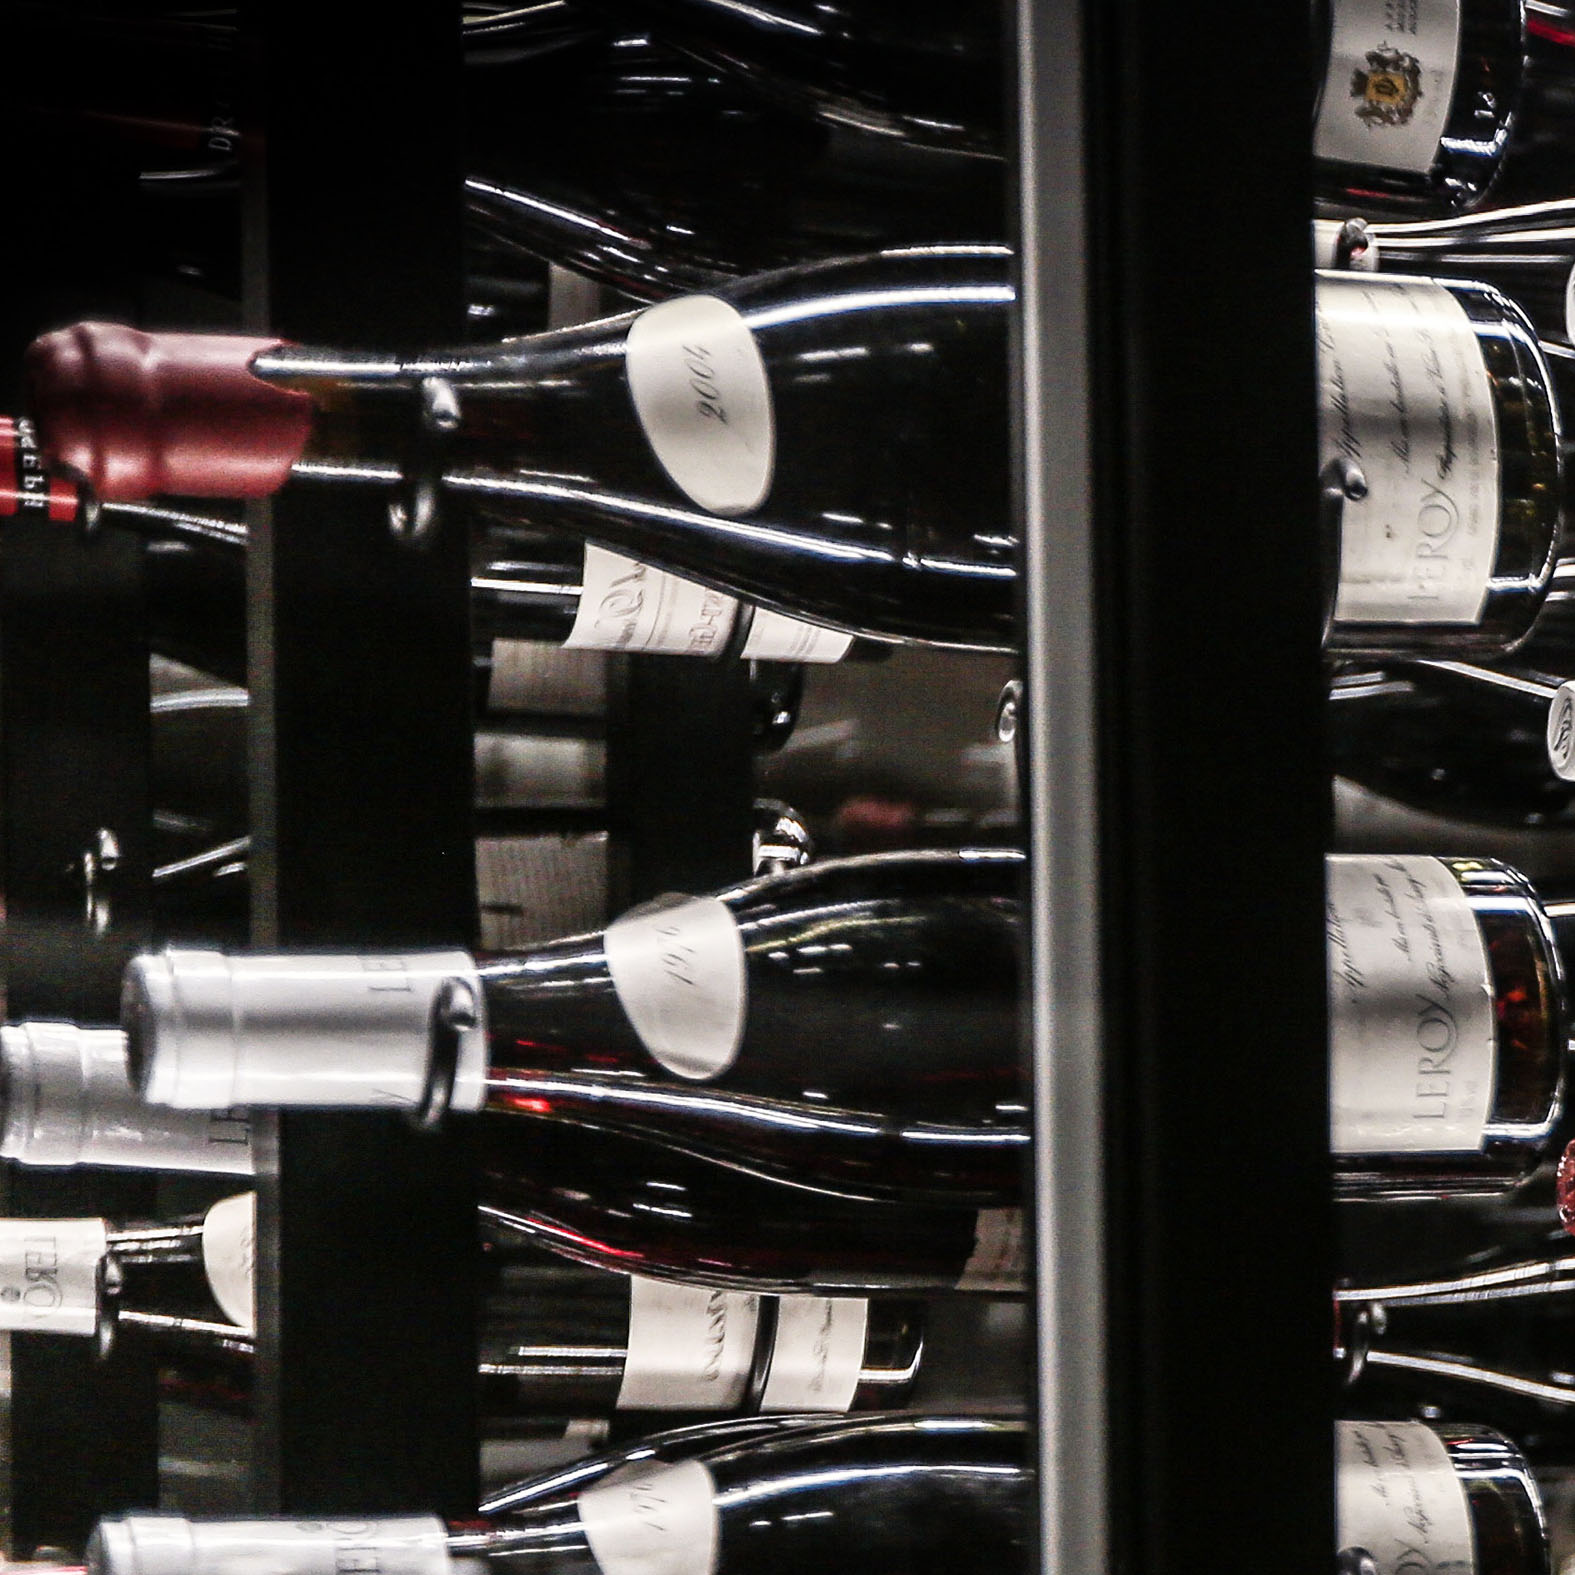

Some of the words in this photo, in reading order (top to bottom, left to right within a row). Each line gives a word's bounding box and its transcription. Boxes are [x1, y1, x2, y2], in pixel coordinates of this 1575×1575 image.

[682, 344, 728, 424] 2004
[1406, 478, 1459, 602] LEROY
[1411, 993, 1458, 1120] LEROY
